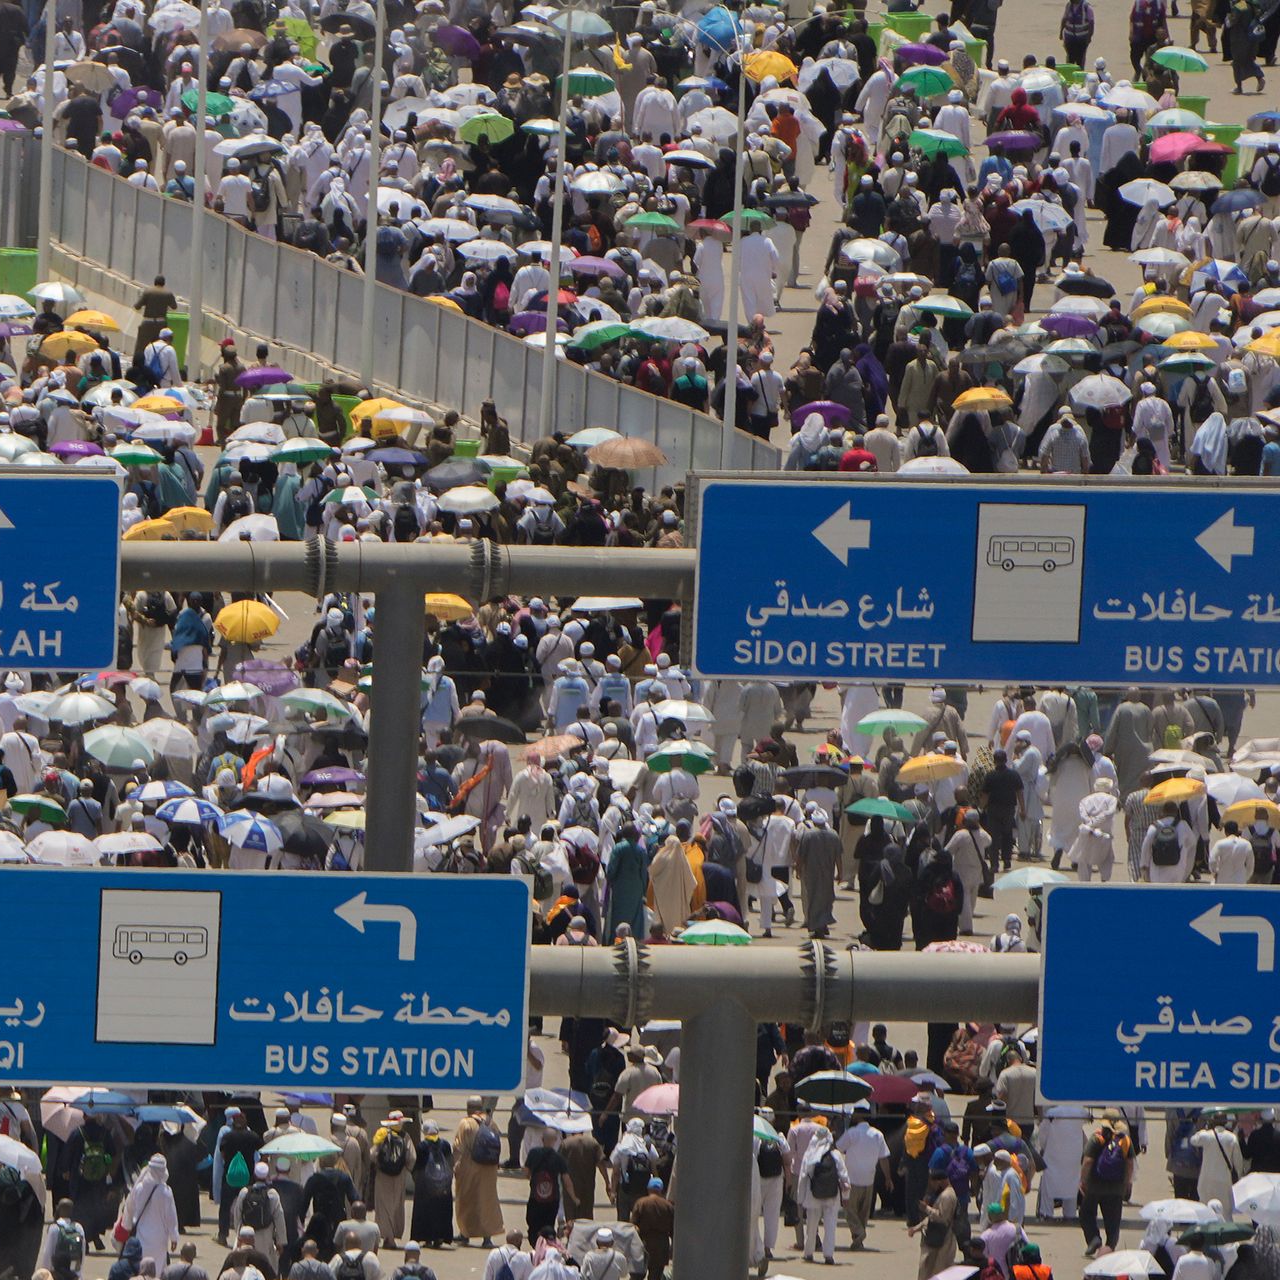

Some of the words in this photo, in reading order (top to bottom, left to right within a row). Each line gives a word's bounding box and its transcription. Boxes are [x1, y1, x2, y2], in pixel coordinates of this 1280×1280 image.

[20, 582, 78, 612] مكة
[746, 580, 849, 636] صدقي
[858, 588, 934, 629] شارع
[1093, 589, 1232, 621] حافلات
[734, 639, 816, 665] SIDQI
[826, 642, 946, 667] STREET
[1125, 646, 1183, 671] BUS
[229, 987, 383, 1023] حافلات
[394, 993, 510, 1026] محطة
[1116, 996, 1252, 1052] صدقي
[265, 1045, 329, 1074] BUS
[341, 1047, 474, 1077] STATION
[1135, 1061, 1215, 1088] RIEA
